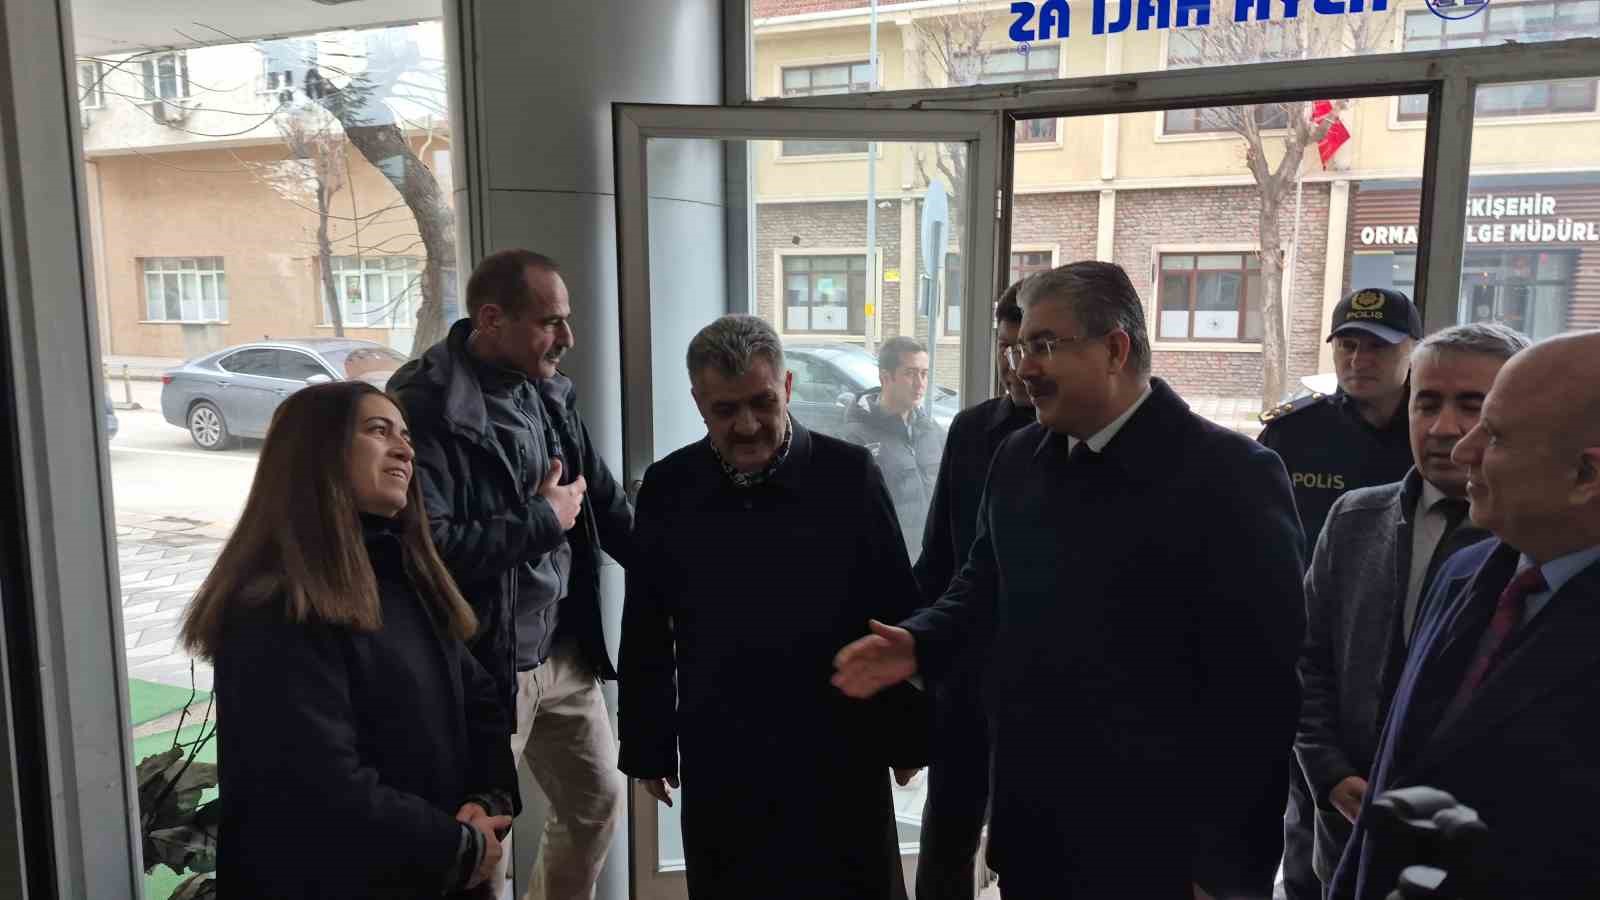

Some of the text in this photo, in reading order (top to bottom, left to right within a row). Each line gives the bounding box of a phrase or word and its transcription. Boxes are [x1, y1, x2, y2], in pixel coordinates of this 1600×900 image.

[1466, 192, 1556, 220] KİŞEHİR
[1360, 218, 1600, 245] ORMA LGE MÜDÜRL
